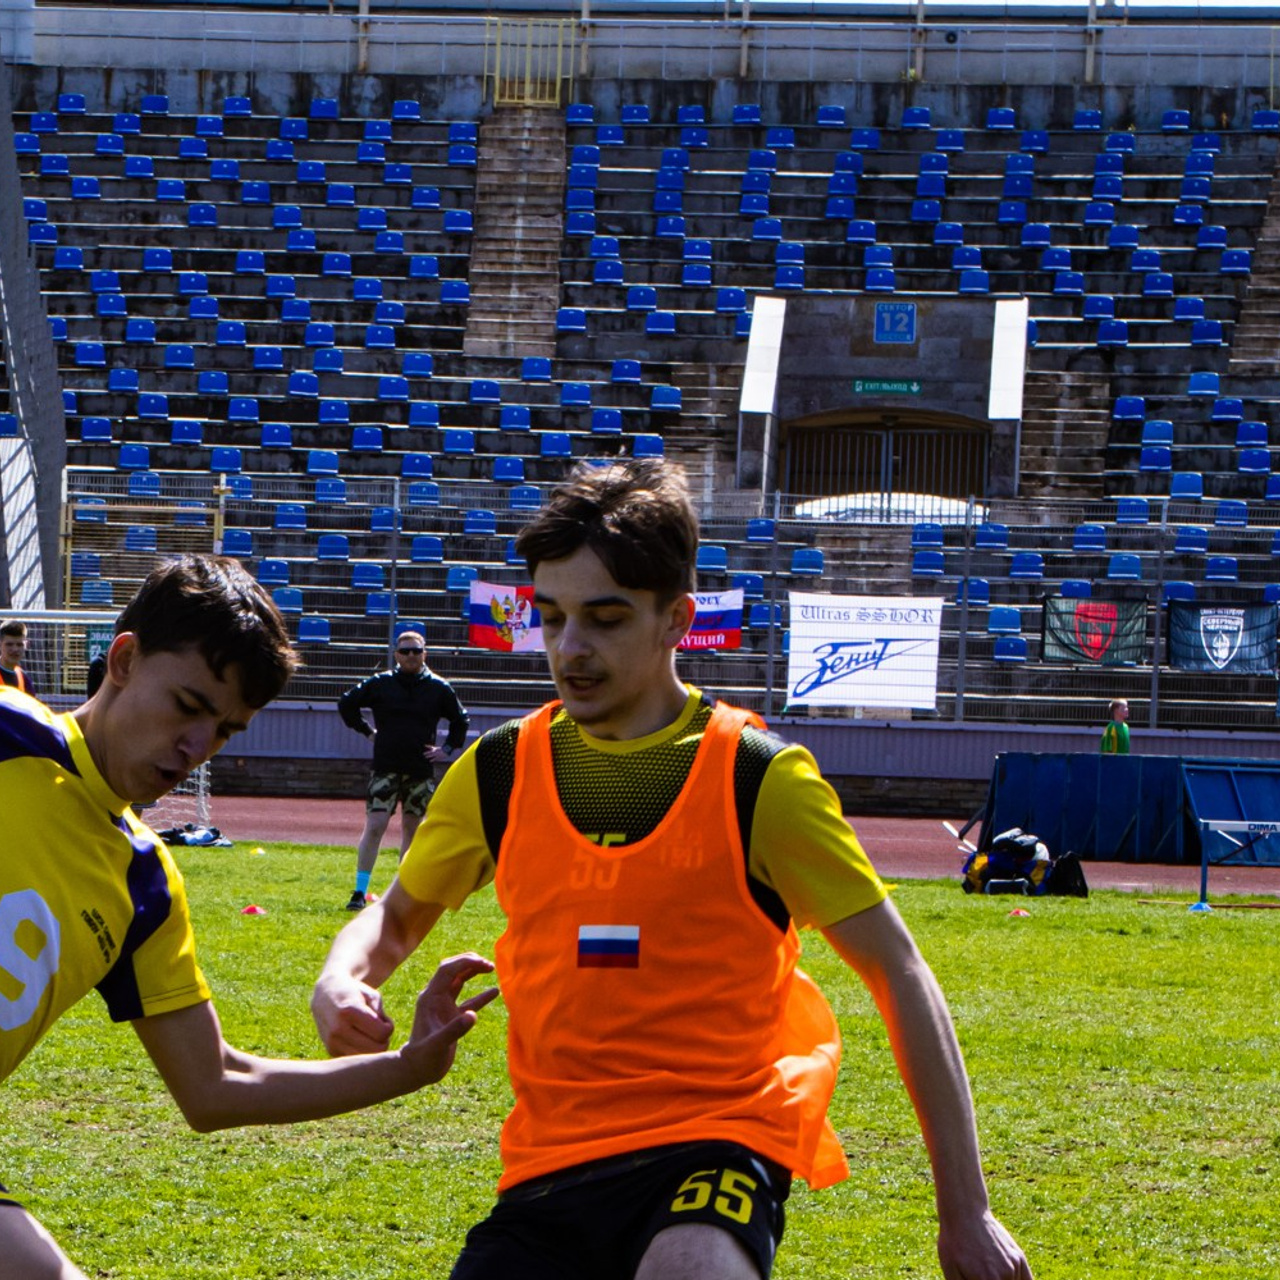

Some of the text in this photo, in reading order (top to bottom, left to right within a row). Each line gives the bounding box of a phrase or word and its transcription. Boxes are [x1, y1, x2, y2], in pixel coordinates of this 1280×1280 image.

[882, 312, 910, 332] 12
[801, 605, 851, 621] Ultras
[1248, 823, 1277, 831] DIMA
[670, 1167, 758, 1225] 55
